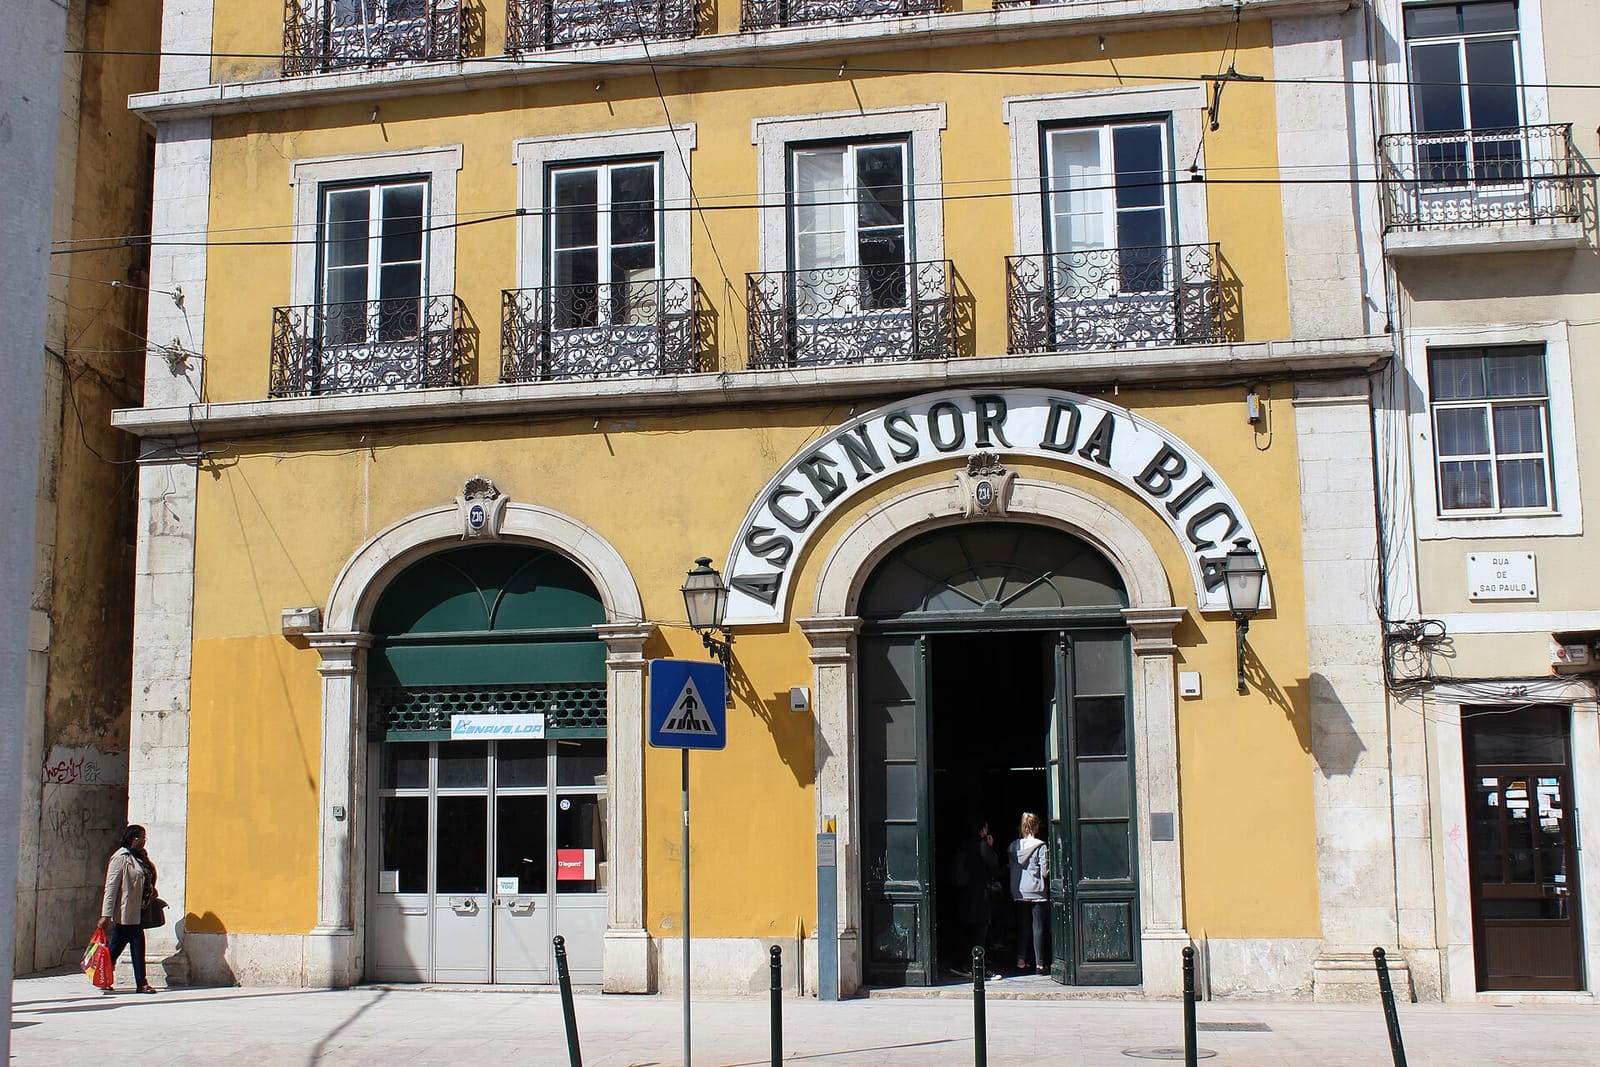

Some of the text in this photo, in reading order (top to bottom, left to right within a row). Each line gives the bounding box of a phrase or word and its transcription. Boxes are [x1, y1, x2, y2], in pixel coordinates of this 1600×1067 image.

[979, 488, 991, 499] 234
[729, 394, 1014, 605] ASCENSOR
[1038, 398, 1116, 467] DA
[472, 511, 483, 522] 236
[1492, 558, 1509, 566] RUA
[1496, 571, 1508, 579] DE
[1498, 583, 1527, 592] PAULO
